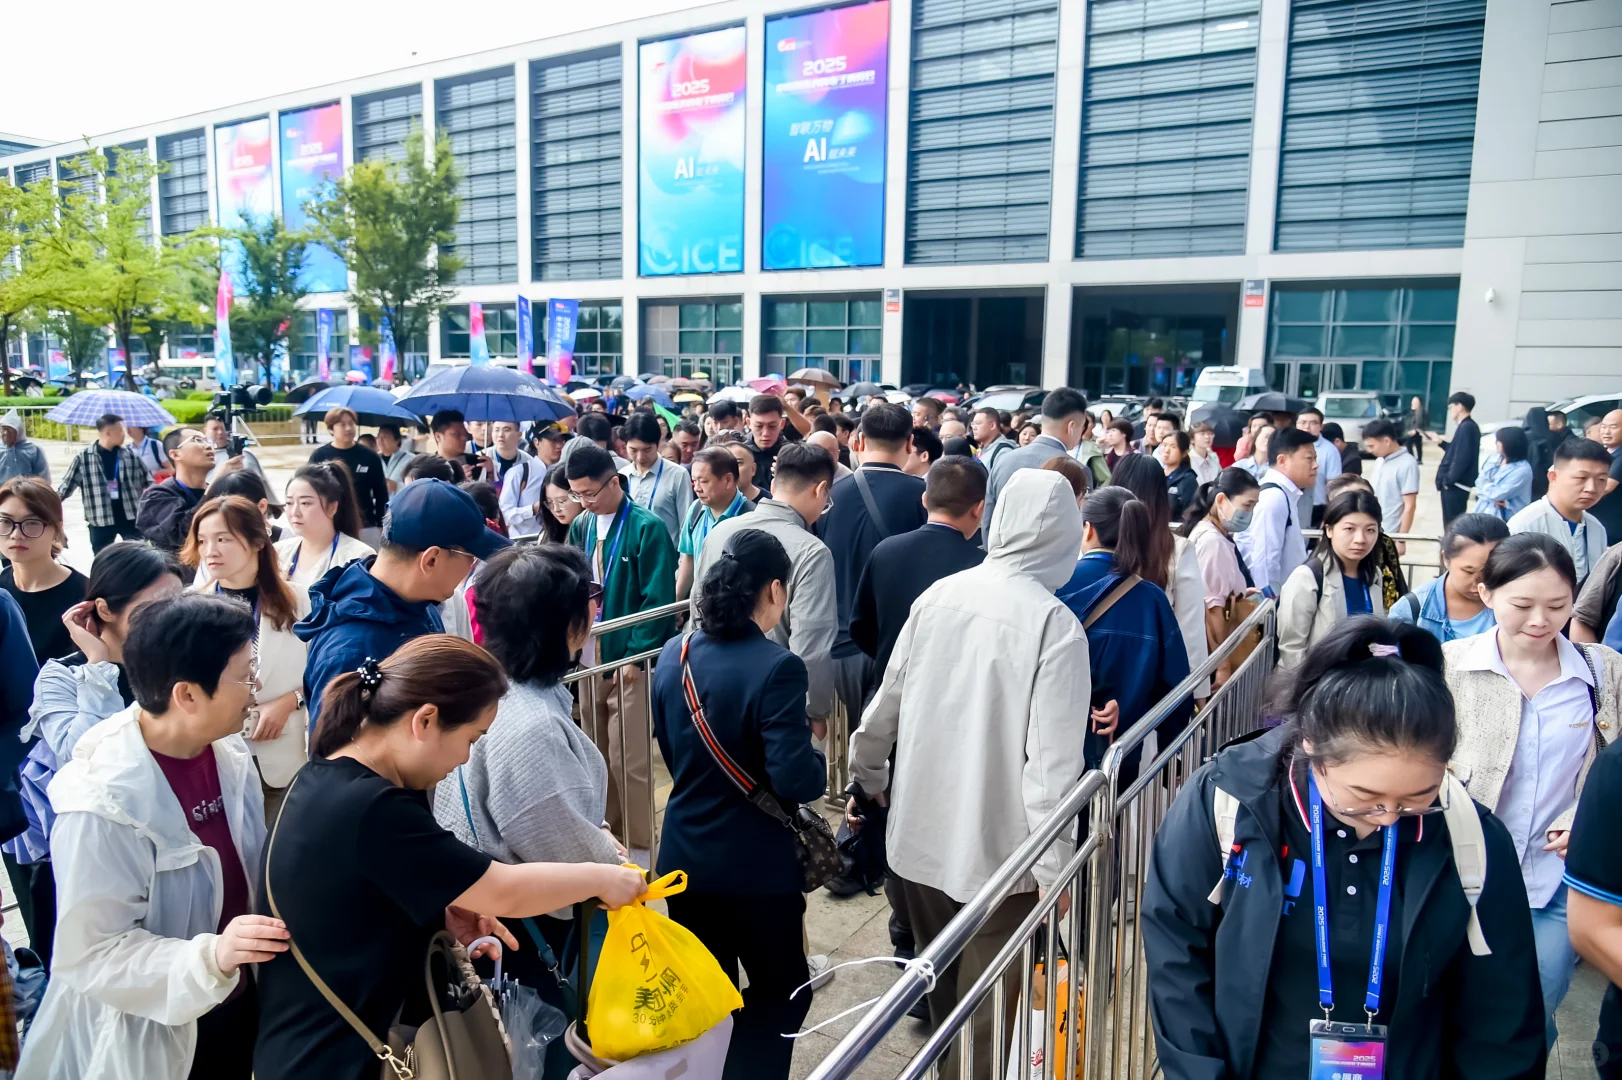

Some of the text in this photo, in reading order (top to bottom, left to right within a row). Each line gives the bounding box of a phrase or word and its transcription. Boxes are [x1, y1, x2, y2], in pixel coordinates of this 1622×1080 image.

[803, 56, 847, 77] 2025
[671, 78, 710, 98] 2025
[803, 137, 827, 163] AI
[673, 157, 695, 180] AI
[1312, 804, 1320, 824] 2025
[1382, 866, 1391, 886] 2025
[1353, 1055, 1377, 1063] 2025
